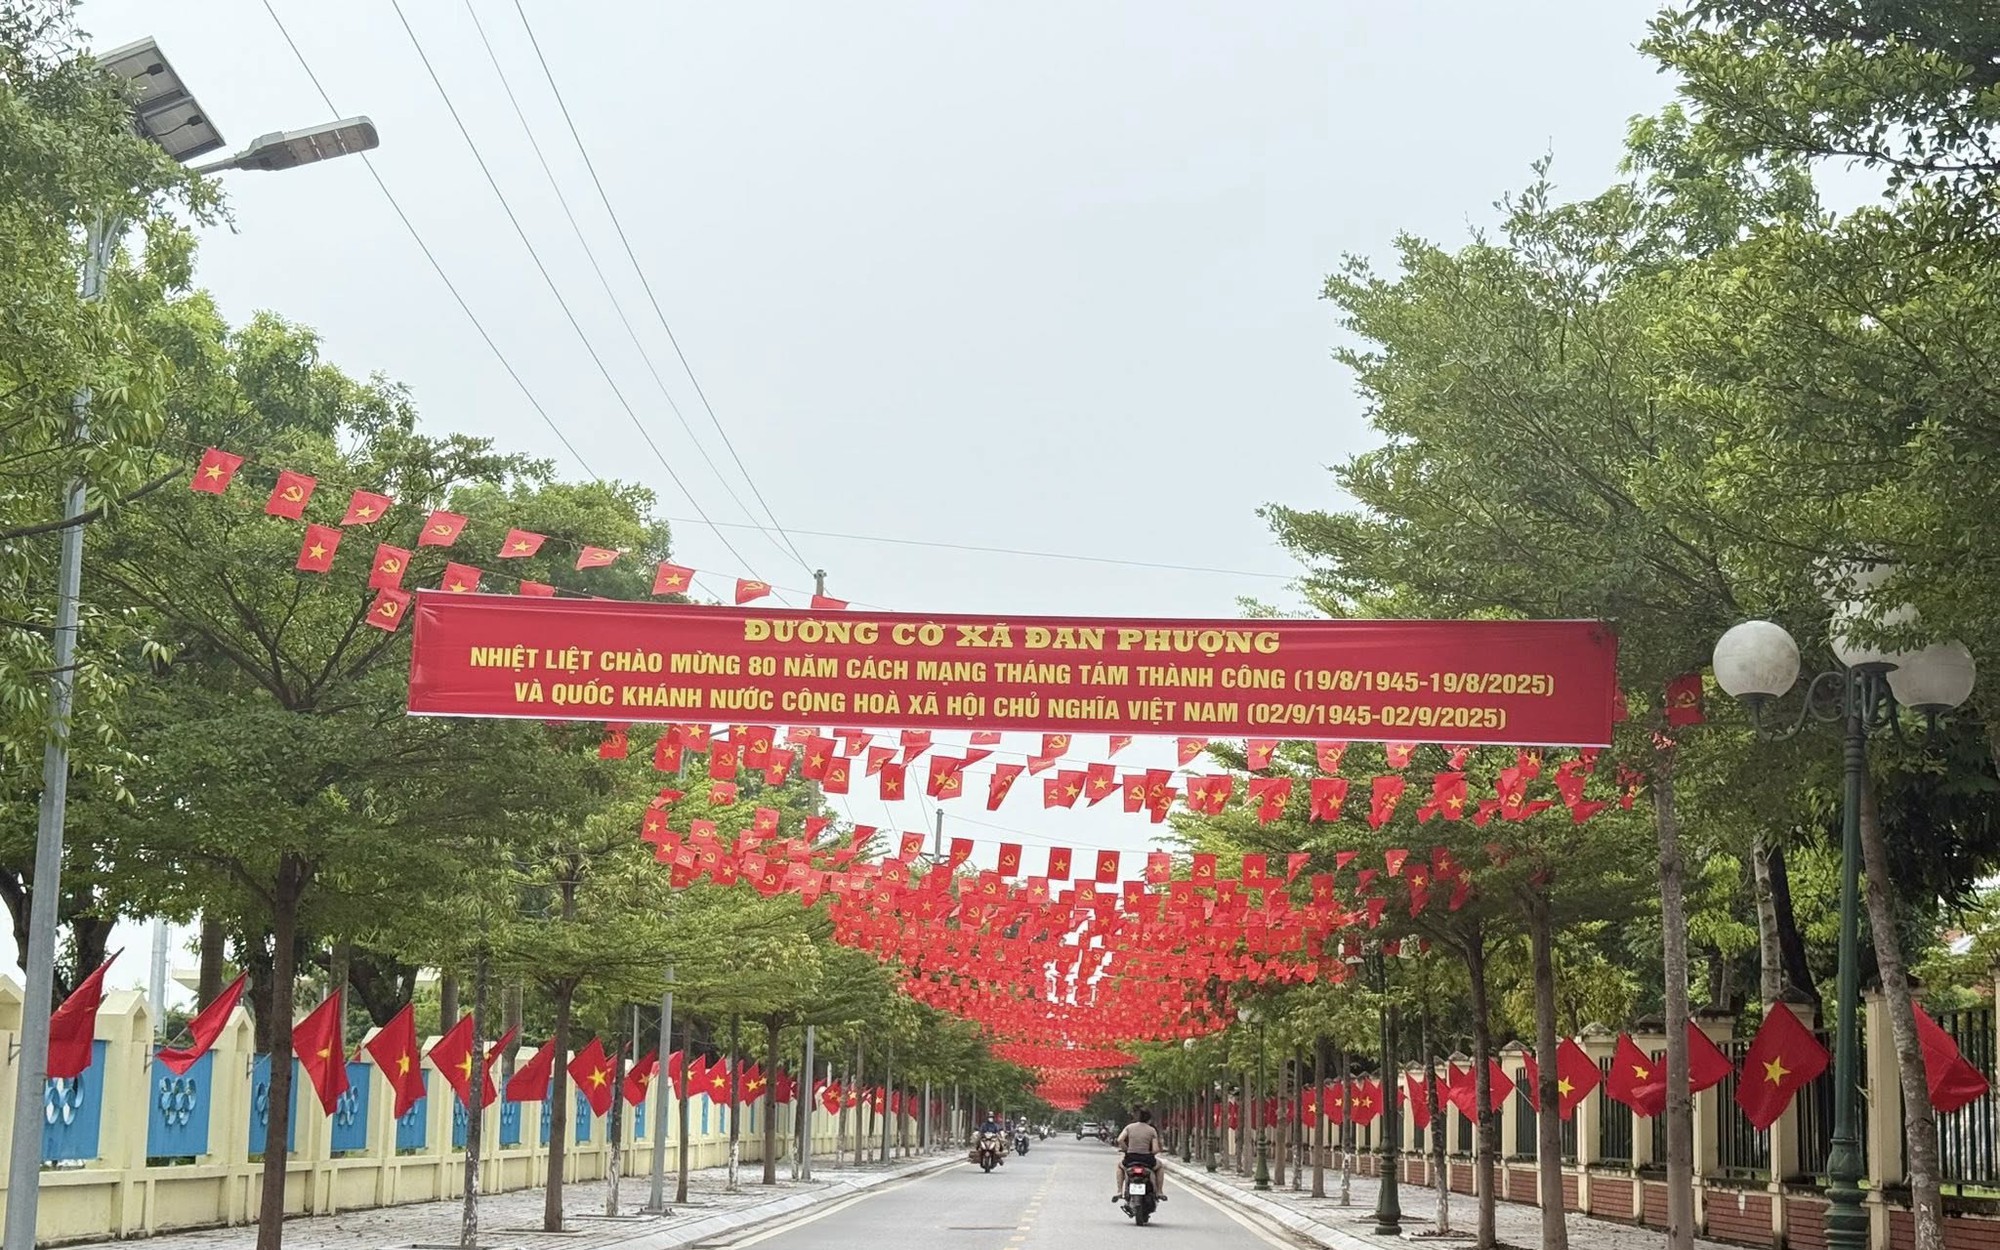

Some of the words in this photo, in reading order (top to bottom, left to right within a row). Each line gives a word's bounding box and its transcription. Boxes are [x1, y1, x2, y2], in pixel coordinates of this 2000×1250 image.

[743, 617, 880, 645] ĐƯỜNG
[891, 620, 947, 647] CỜ
[955, 622, 1014, 649] XÃ
[1024, 625, 1106, 651] ĐAN
[1116, 626, 1280, 658] PHƯỢNG
[470, 643, 540, 673] NHIỆT
[545, 645, 594, 675] LIỆT
[599, 647, 663, 673] CHÀO
[670, 650, 741, 676] MỪNG
[748, 655, 777, 677] 80
[783, 653, 839, 679] NĂM
[845, 655, 909, 681] CÁCH
[916, 660, 987, 686] MẠNG
[994, 660, 1071, 685] THÁNG
[1078, 661, 1129, 686] TÁM
[1135, 662, 1214, 688] THÀNH
[1221, 664, 1286, 690] CÔNG
[1294, 669, 1554, 697] (19/8/1945-19/8/2025)
[514, 678, 544, 703] VÀ
[551, 677, 615, 706] QUỐC
[621, 682, 703, 709] KHÁNH
[709, 686, 774, 711] NƯỚC
[781, 687, 846, 716] CỘNG
[853, 690, 901, 714] HOÀ
[907, 691, 940, 716] XÃ
[946, 692, 986, 720] HỘI
[993, 691, 1040, 718] CHỦ
[1047, 696, 1120, 720] NGHĨA
[1127, 697, 1177, 725] VIỆT
[1183, 701, 1239, 723] NAM
[1247, 703, 1506, 730] (02/9/1945-02/9/2025)
